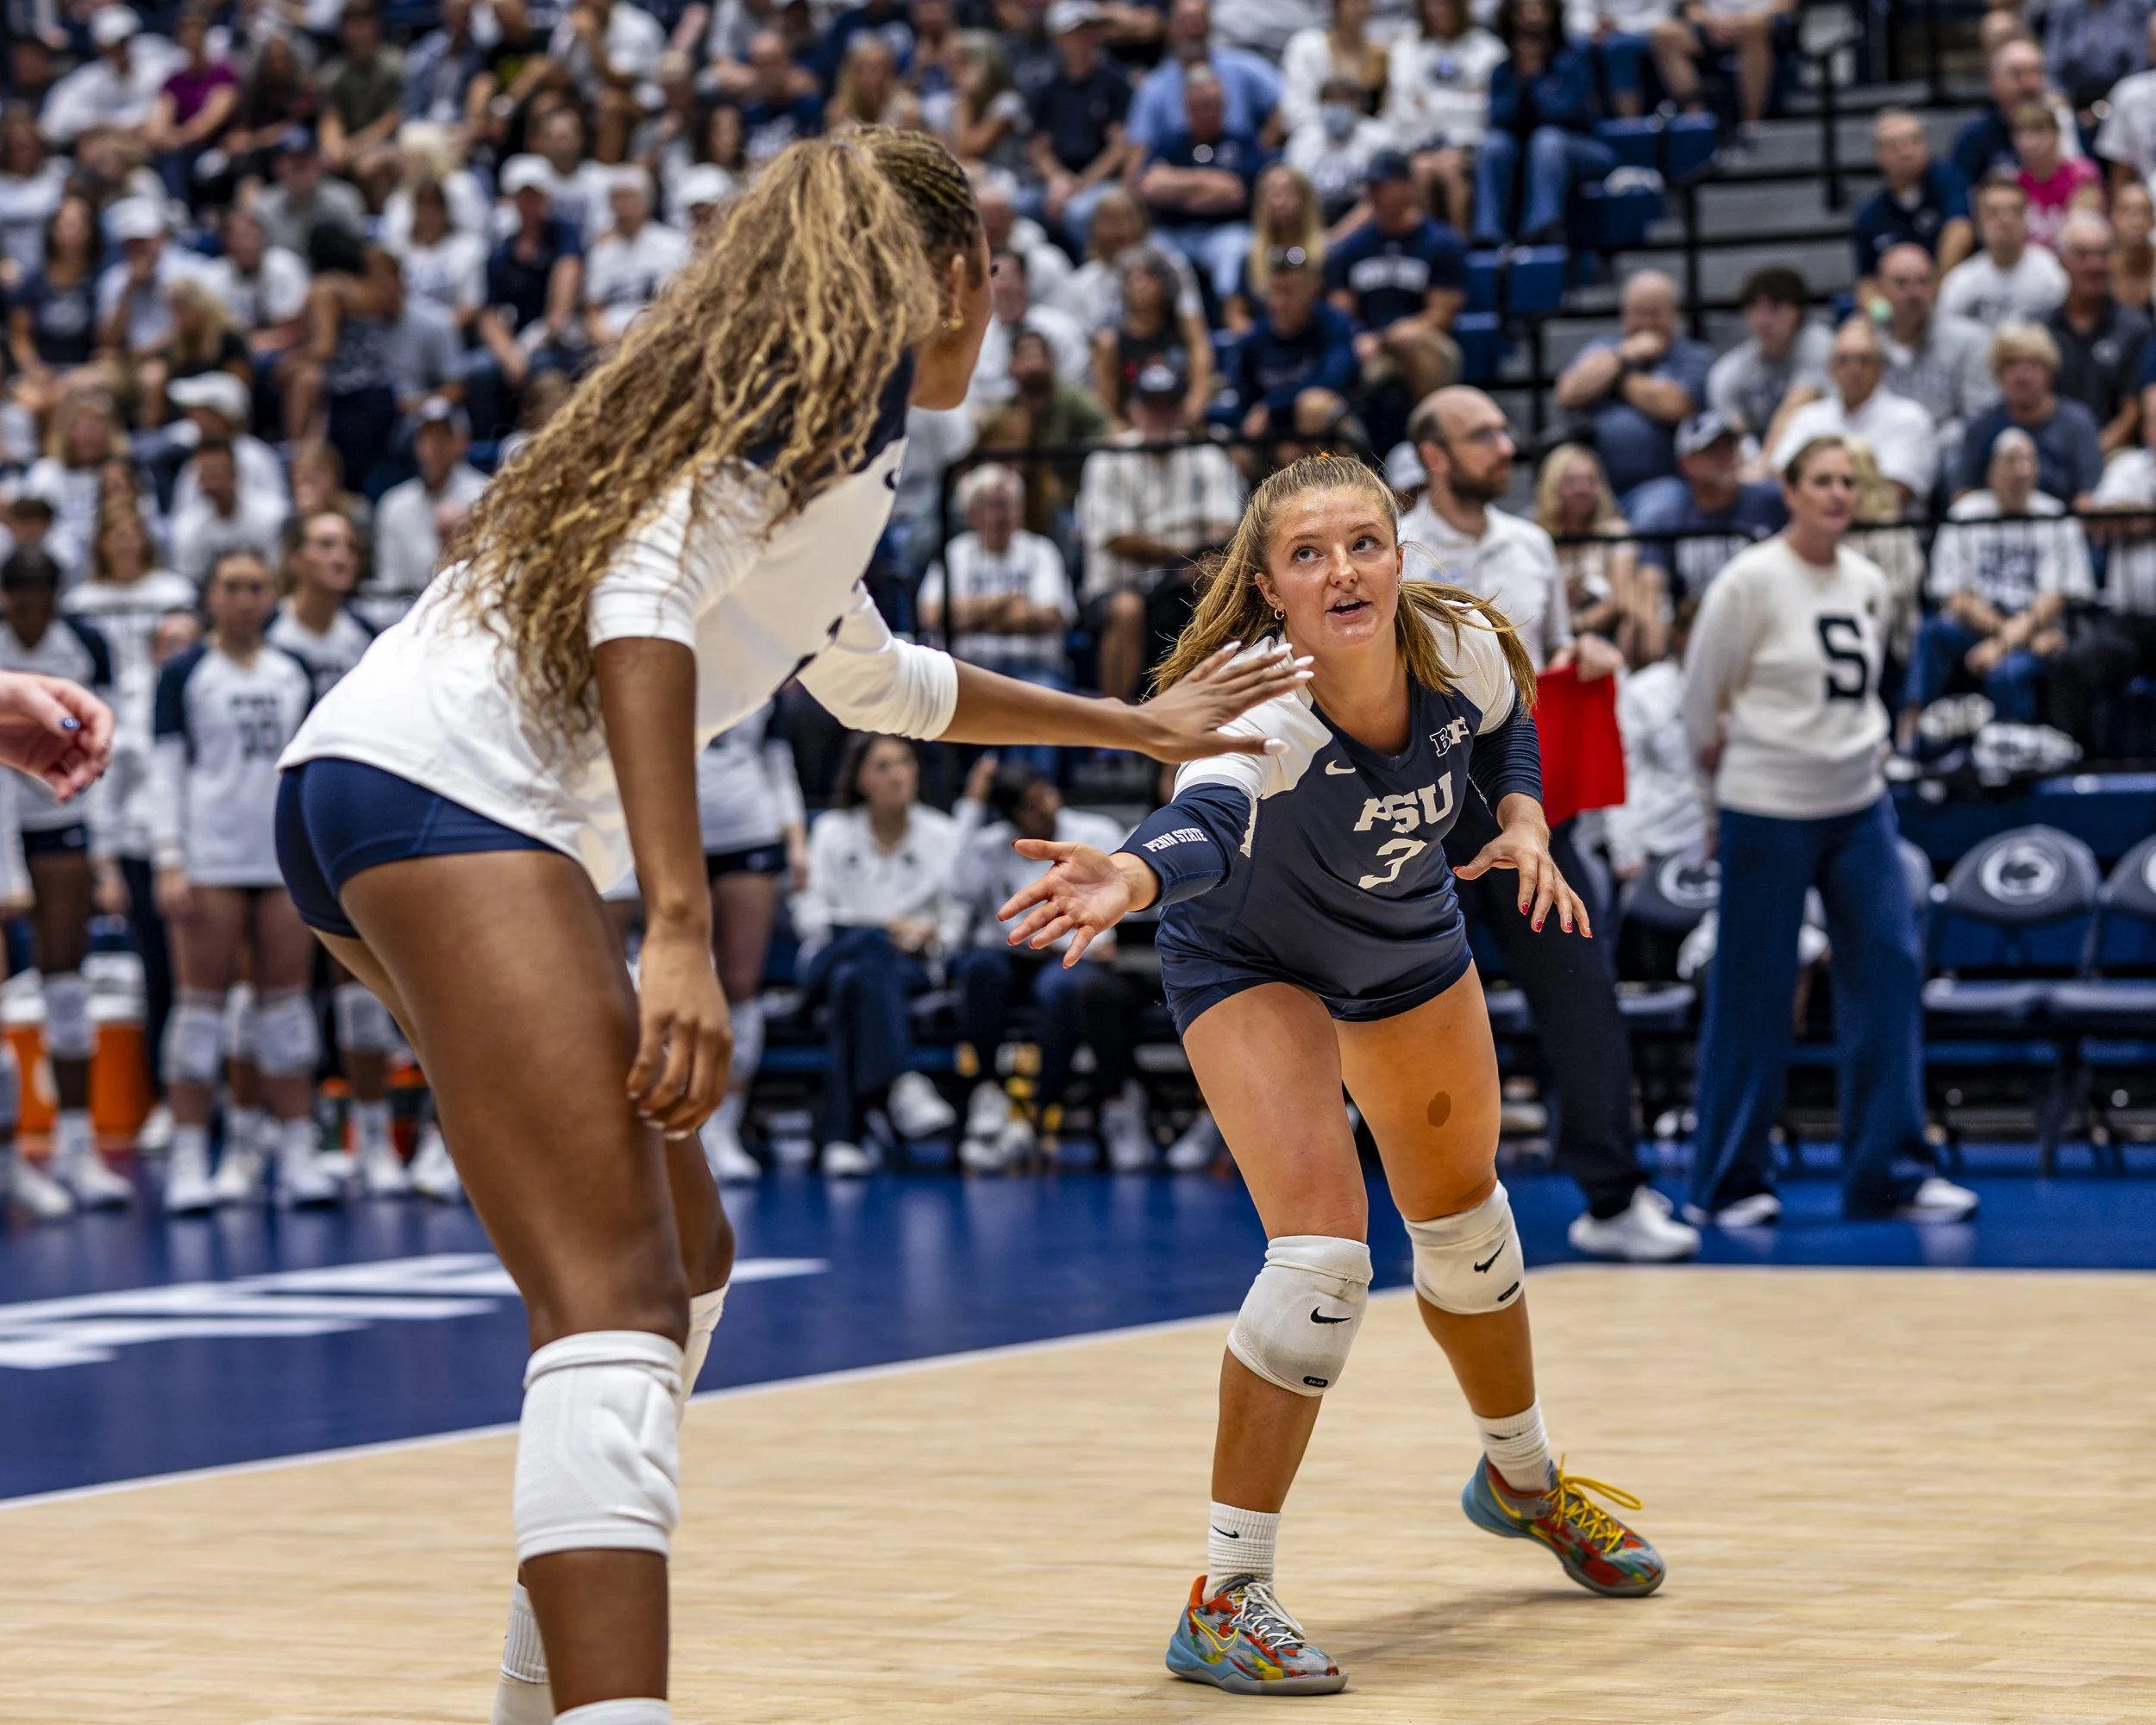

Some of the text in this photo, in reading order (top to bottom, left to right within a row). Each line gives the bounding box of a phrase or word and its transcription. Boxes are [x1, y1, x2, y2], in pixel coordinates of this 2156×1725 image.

[1816, 615, 1867, 701] S
[1353, 770, 1454, 834] PSU
[1142, 828, 1208, 852] PENN STATE
[1357, 837, 1428, 889] 3
